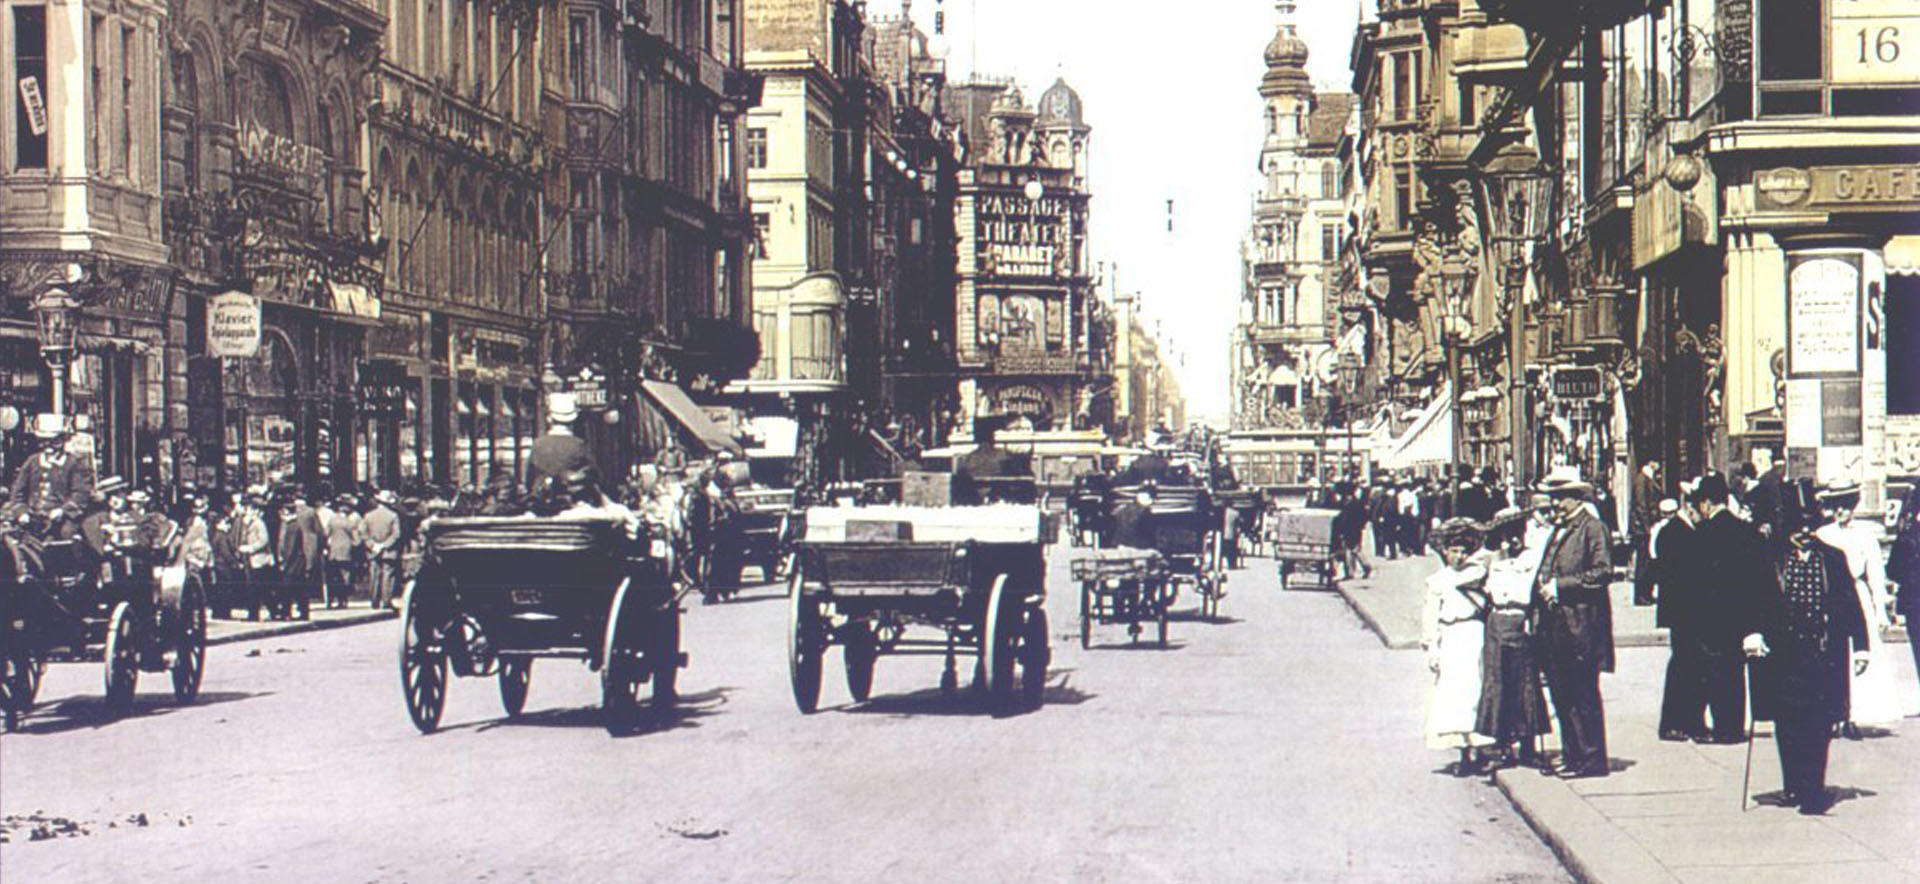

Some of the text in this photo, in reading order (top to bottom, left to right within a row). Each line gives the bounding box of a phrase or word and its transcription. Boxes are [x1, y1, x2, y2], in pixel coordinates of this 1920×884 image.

[1857, 26, 1900, 63] 16
[982, 195, 1063, 217] PASSAGE
[981, 220, 1065, 245] THEATER
[993, 244, 1054, 263] CABARET
